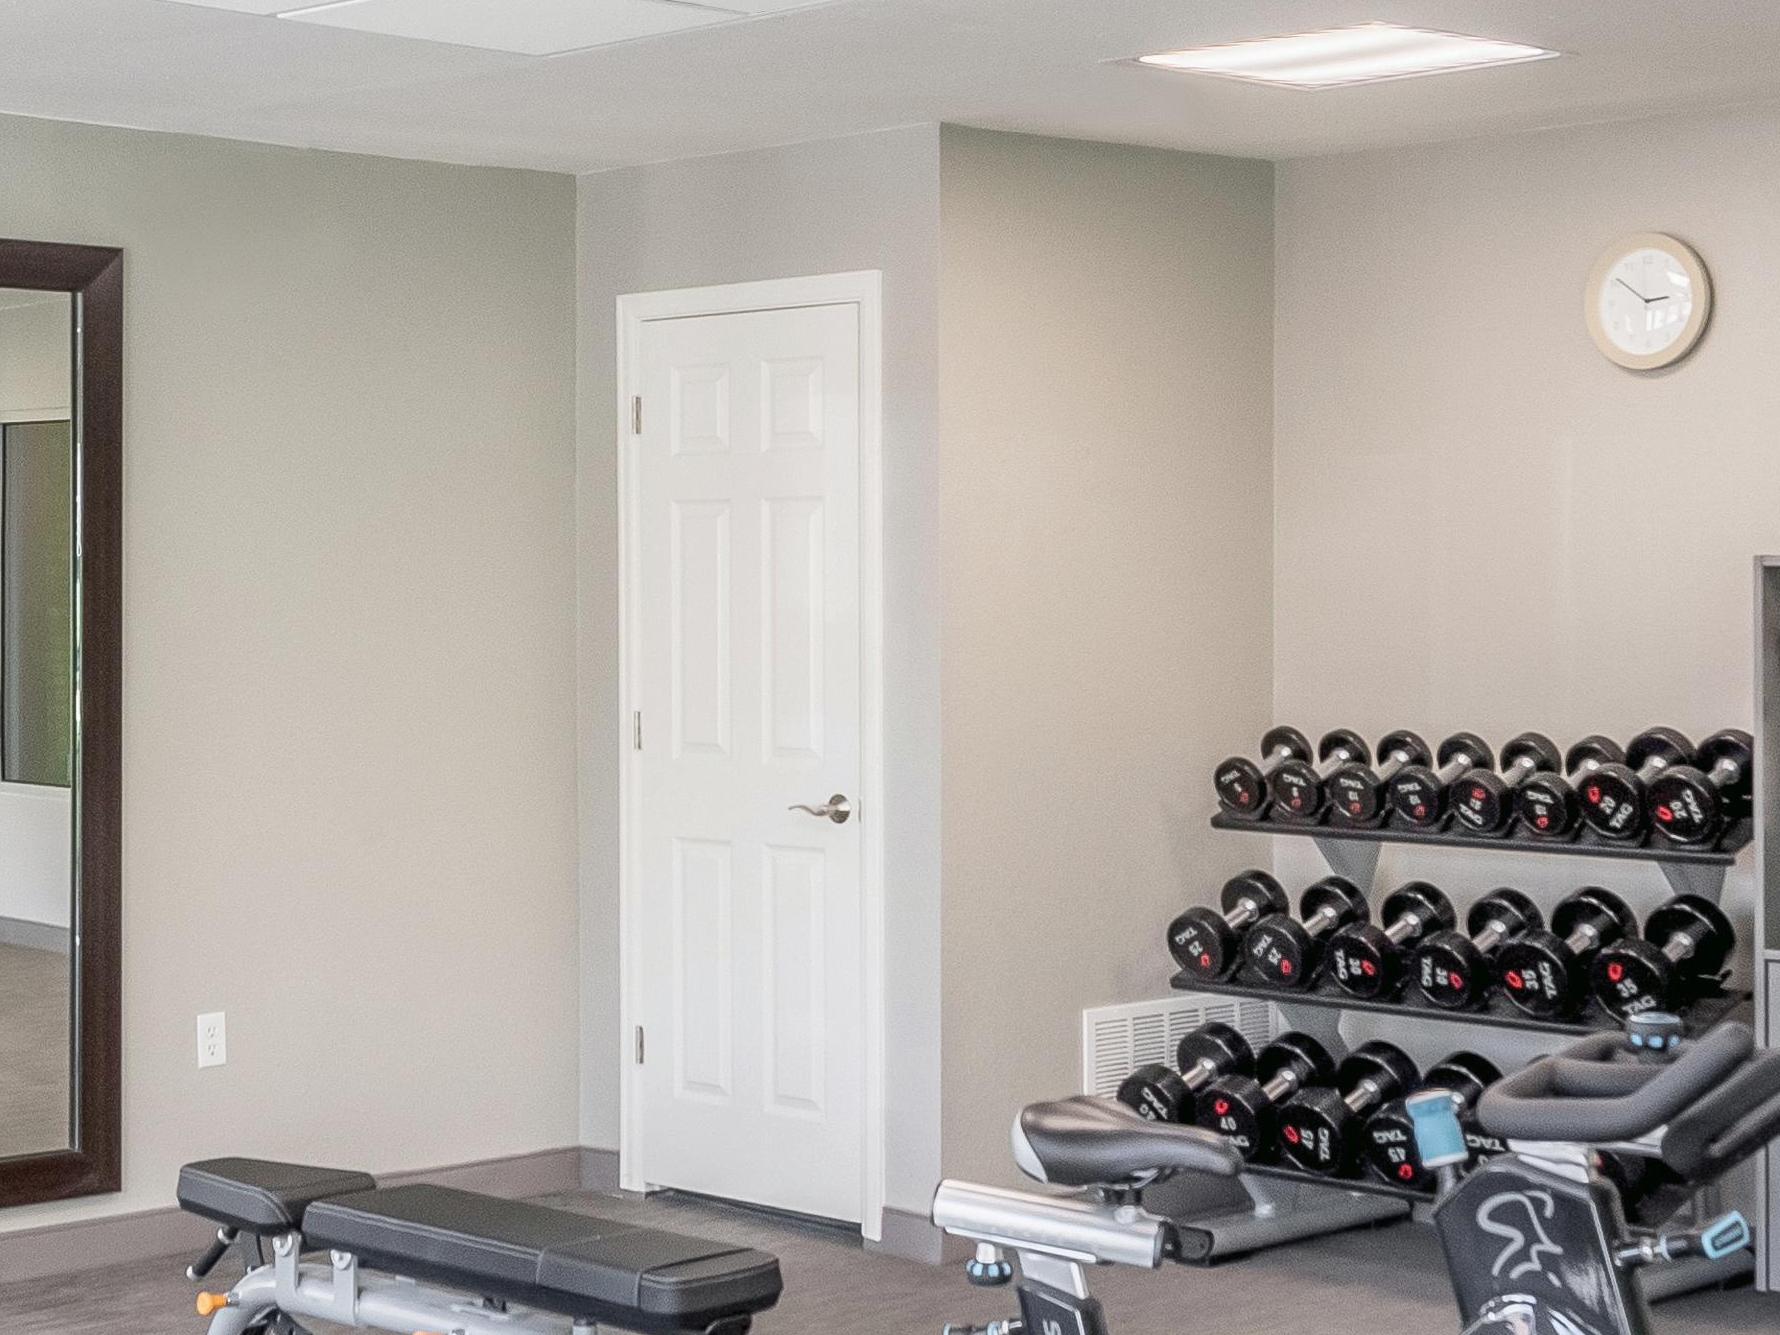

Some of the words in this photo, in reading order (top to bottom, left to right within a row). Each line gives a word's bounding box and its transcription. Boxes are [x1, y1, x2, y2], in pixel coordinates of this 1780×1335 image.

[1340, 778, 1364, 790] TAG
[1397, 783, 1422, 794] TAG
[1525, 790, 1555, 804] TAG
[1681, 789, 1704, 824] TAG
[1609, 803, 1634, 829] TAG
[1669, 801, 1688, 819] 20
[1174, 927, 1198, 946] TAG
[1252, 934, 1273, 958] TAG
[1334, 949, 1348, 980] TAG
[1421, 956, 1433, 987] TAG
[1521, 969, 1539, 990] 35
[1538, 962, 1558, 999] TAG
[1617, 978, 1638, 998] 35
[1622, 995, 1657, 1015] TAG
[1142, 1087, 1168, 1119] TAG
[1220, 1117, 1237, 1131] 40
[1228, 1135, 1250, 1147] AG
[1300, 1128, 1314, 1150] 45
[1318, 1128, 1330, 1161] TAG
[1373, 1129, 1407, 1144] TAG
[1465, 1134, 1505, 1151] TAG
[1388, 1146, 1406, 1163] 45
